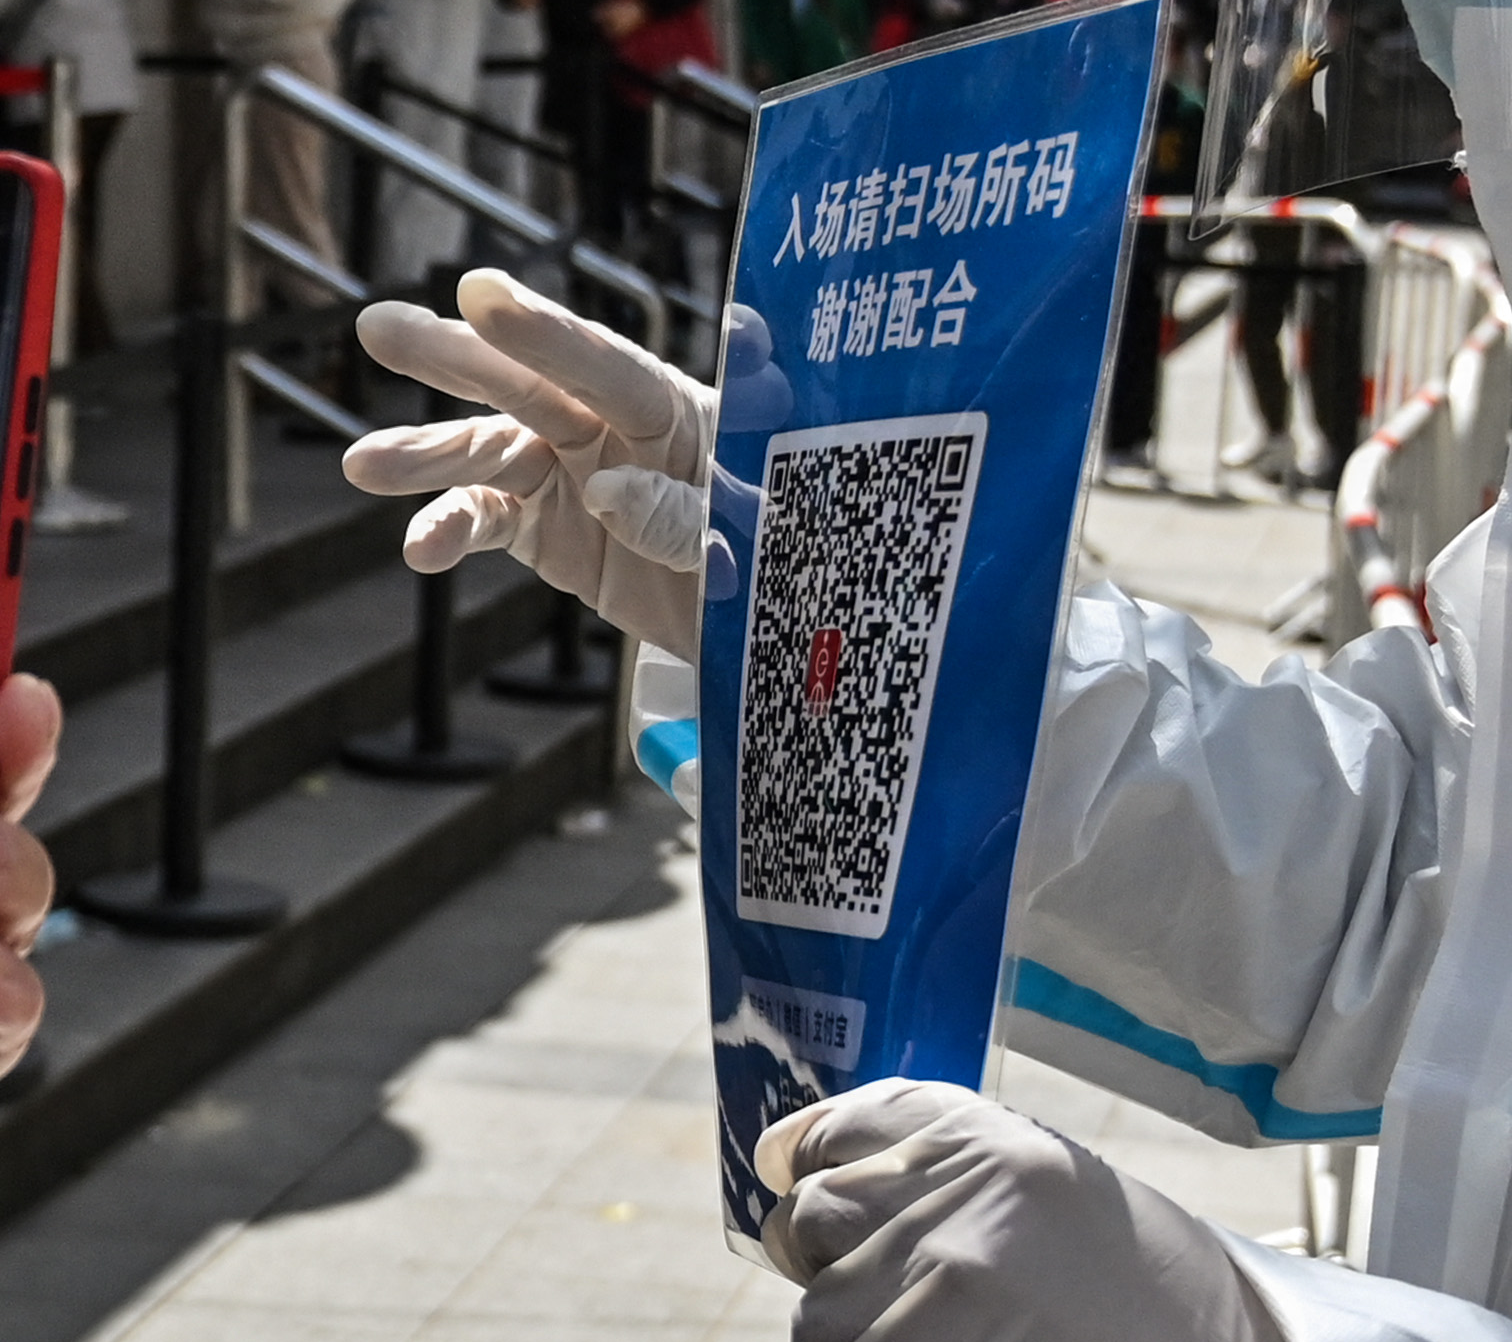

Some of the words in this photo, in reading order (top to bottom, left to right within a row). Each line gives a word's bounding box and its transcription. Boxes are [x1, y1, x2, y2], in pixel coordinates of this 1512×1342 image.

[772, 130, 1079, 267] 入场请扫场所码
[807, 259, 978, 363] 谢谢配合
